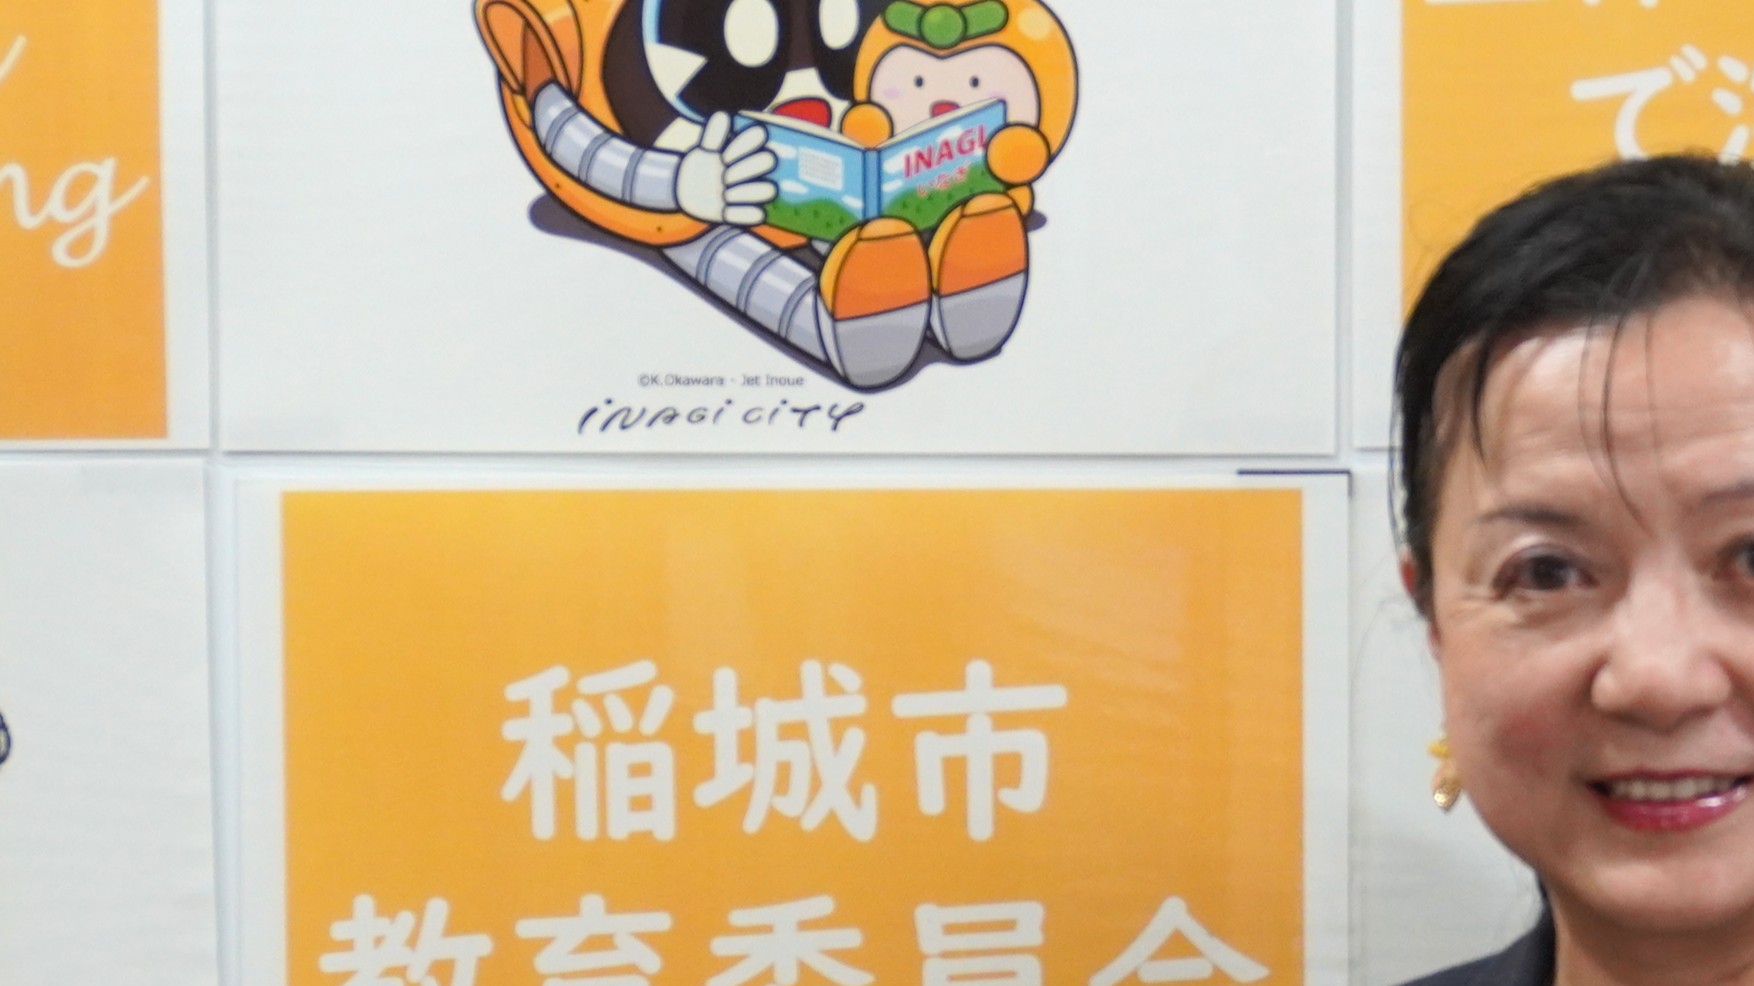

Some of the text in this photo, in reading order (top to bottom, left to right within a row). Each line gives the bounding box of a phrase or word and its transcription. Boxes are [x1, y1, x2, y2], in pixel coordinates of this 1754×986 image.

[904, 122, 987, 178] INAGI
[501, 659, 1068, 841] 稲城市
